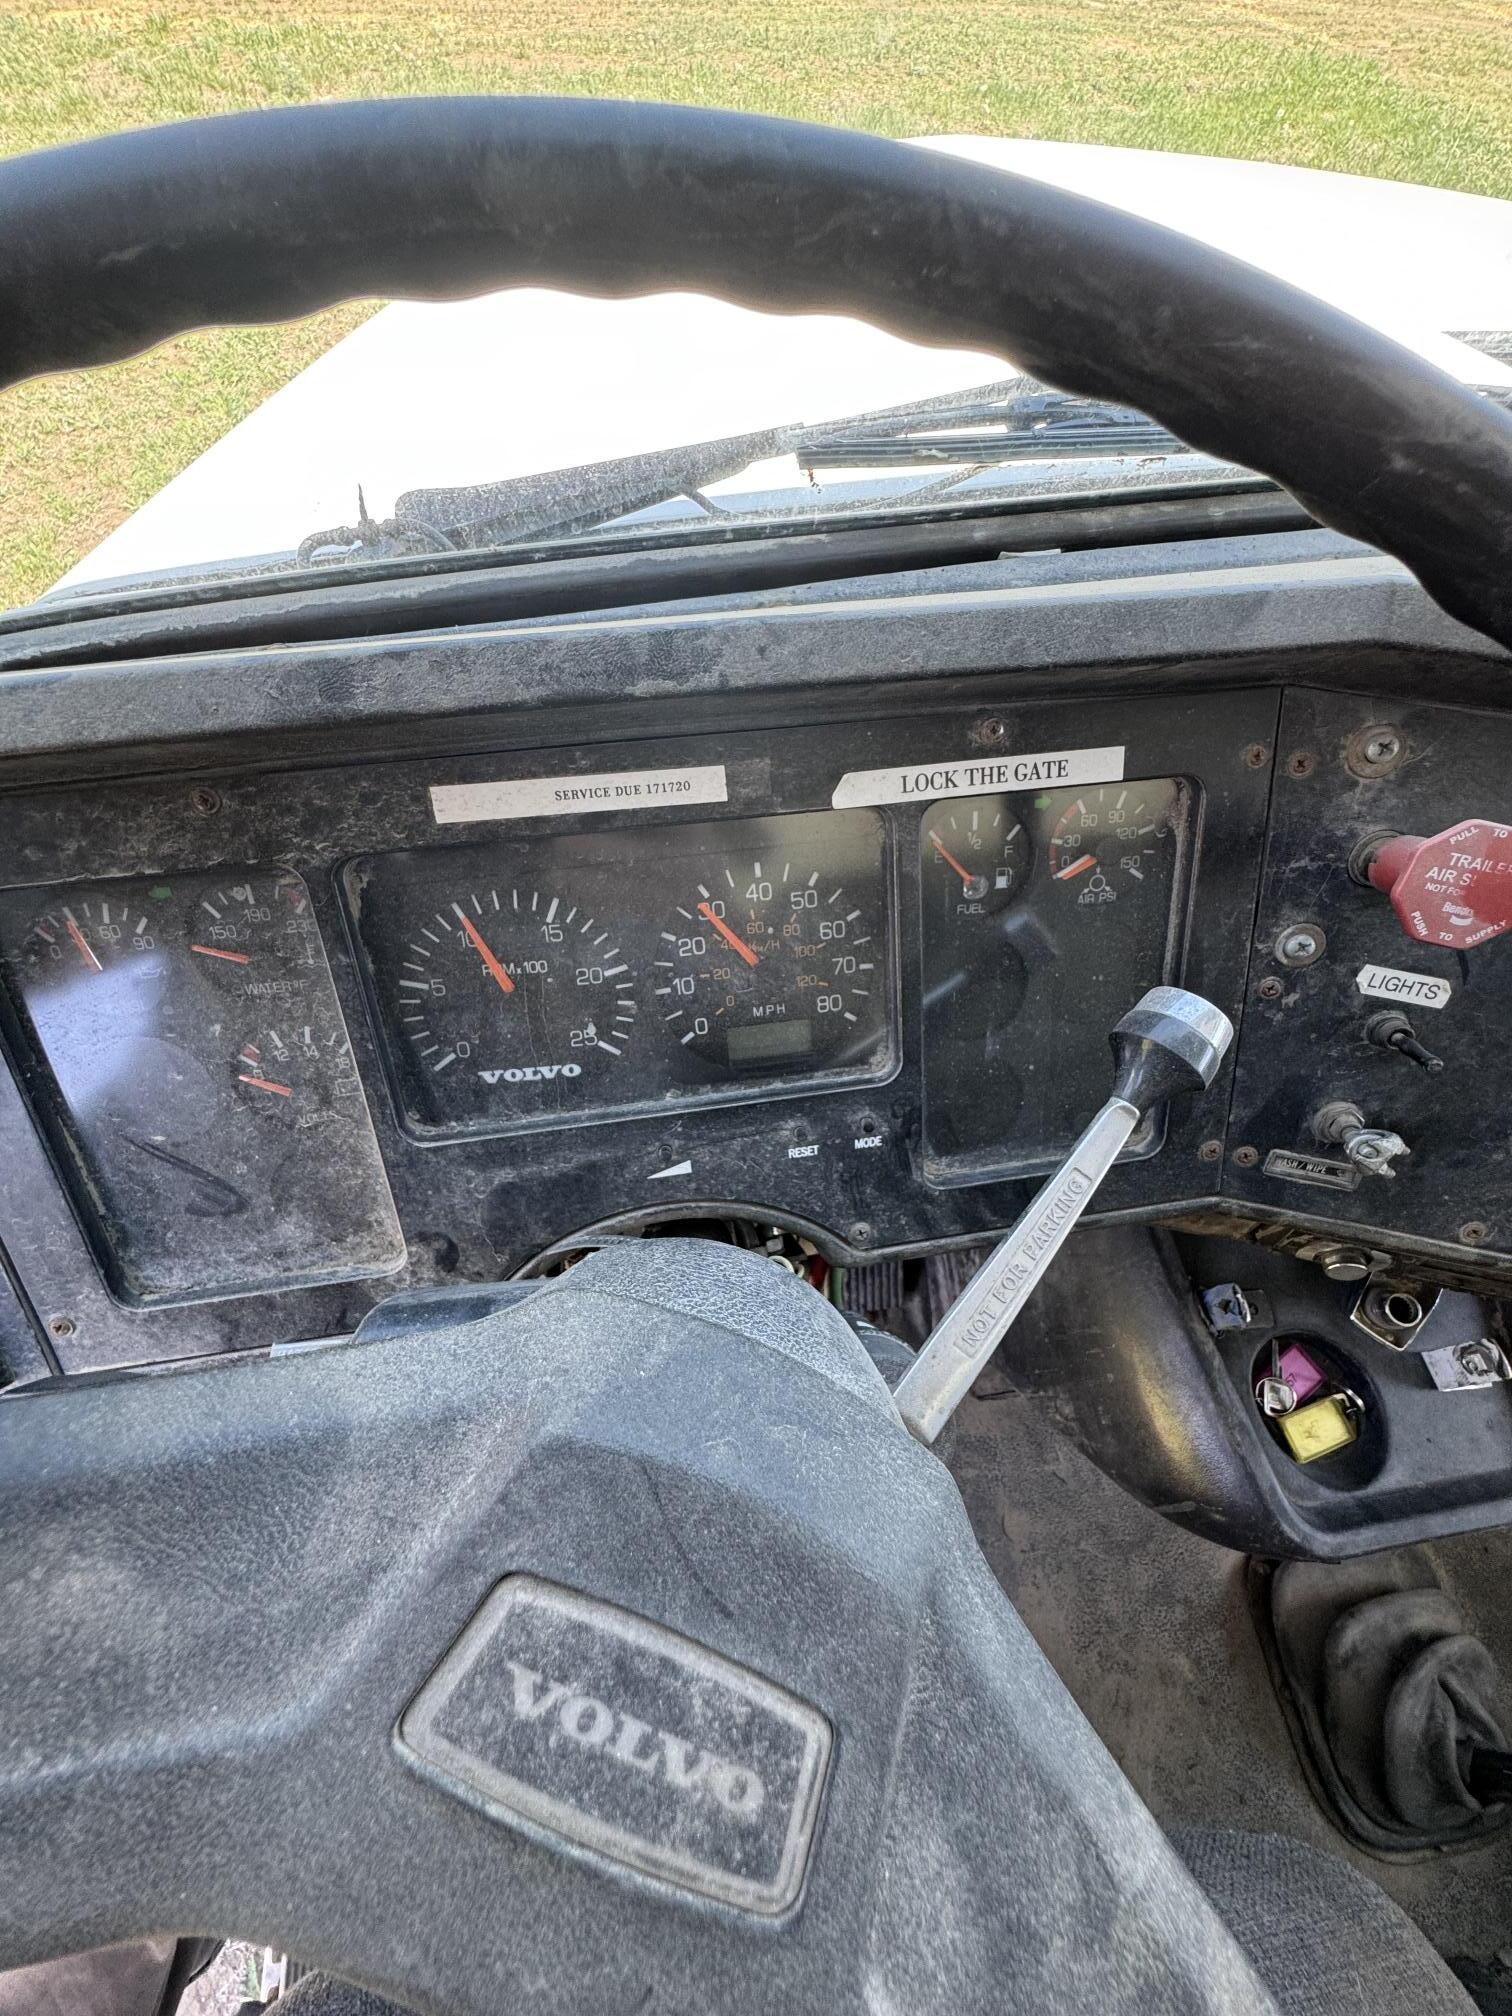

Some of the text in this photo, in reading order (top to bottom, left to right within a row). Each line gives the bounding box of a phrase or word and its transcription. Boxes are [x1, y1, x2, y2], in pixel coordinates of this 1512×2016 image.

[901, 759, 1069, 794] LOCK THE GATE
[554, 780, 691, 801] SERVICE DUE 171720
[1080, 815, 1098, 827] 60
[1108, 810, 1125, 823] 90
[1063, 834, 1081, 848] 30
[1117, 827, 1138, 840] 120
[1449, 826, 1508, 845] PULL TO
[1004, 846, 1013, 859] F
[1120, 856, 1140, 869] 150
[1425, 866, 1457, 883] AIR
[745, 882, 773, 902] 40
[1424, 882, 1448, 893] NOT
[790, 890, 818, 910] 50
[1077, 891, 1117, 904] AIR PSI
[243, 907, 272, 923] 190
[957, 903, 985, 915] FUEL
[100, 924, 121, 940] 60
[208, 924, 237, 941] 150
[540, 924, 564, 943] 15
[746, 922, 765, 934] 60
[783, 924, 801, 936] 80
[819, 920, 846, 940] 60
[1411, 910, 1507, 944] PUSH TO SUPPLY
[132, 935, 155, 951] 90
[678, 937, 706, 957] 20
[51, 945, 62, 960] 0
[832, 956, 857, 975] 70
[576, 966, 604, 986] 20
[713, 968, 731, 980] 20
[796, 974, 817, 987] 120
[430, 978, 446, 997] 5
[672, 977, 695, 995] 10
[1367, 972, 1441, 1000] LIGHTS
[726, 996, 735, 1007] 0
[817, 994, 843, 1013] 80
[752, 1003, 786, 1017] MPH
[695, 1018, 708, 1034] 0
[570, 1030, 598, 1047] 25
[273, 1048, 290, 1061] 12
[456, 1041, 471, 1058] 0
[478, 1063, 582, 1084] VOLVO
[854, 1135, 883, 1150] MODE
[787, 1144, 819, 1159] RESET
[962, 1178, 1083, 1348] NOT FOR PARKING
[507, 1663, 765, 1813] VOLVO
